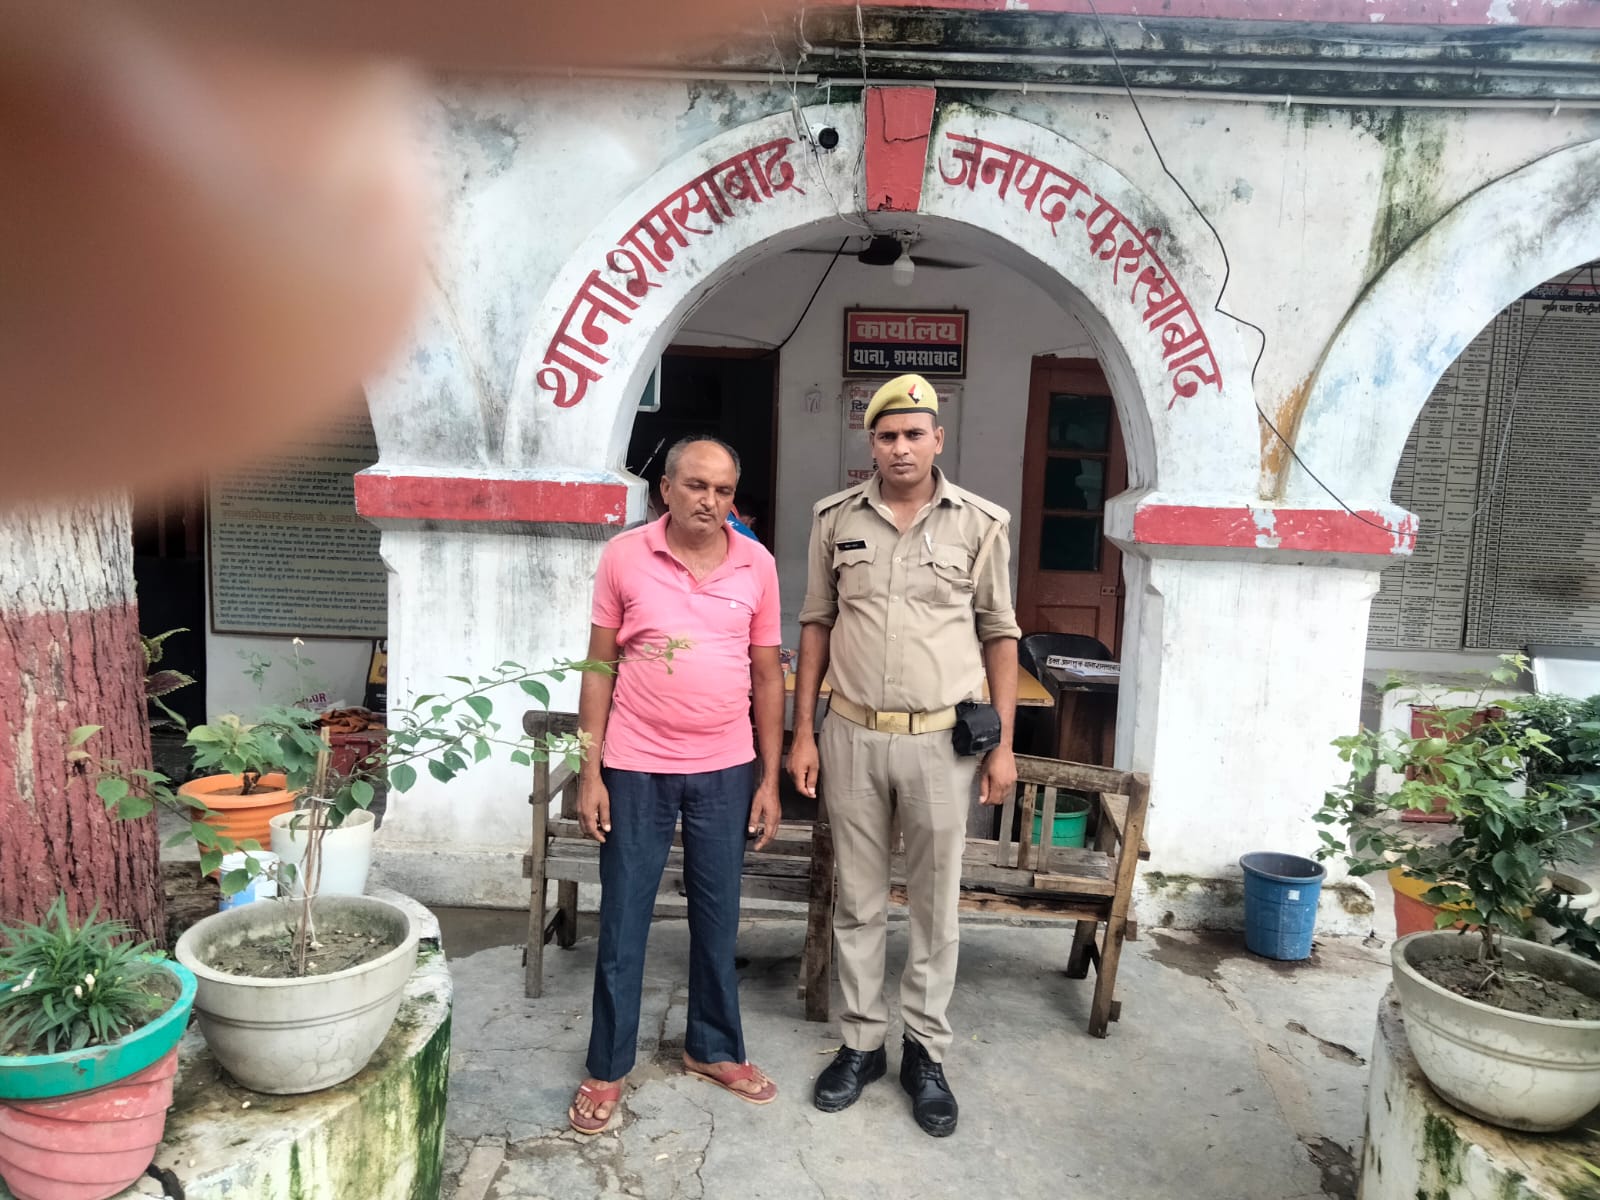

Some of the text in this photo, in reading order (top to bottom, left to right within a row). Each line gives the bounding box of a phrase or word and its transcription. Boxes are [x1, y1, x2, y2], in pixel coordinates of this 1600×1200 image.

[536, 137, 806, 408] थाना शमसाबाद
[856, 317, 957, 341] कार्यालय
[853, 349, 958, 368] थाना, शमसाबाद
